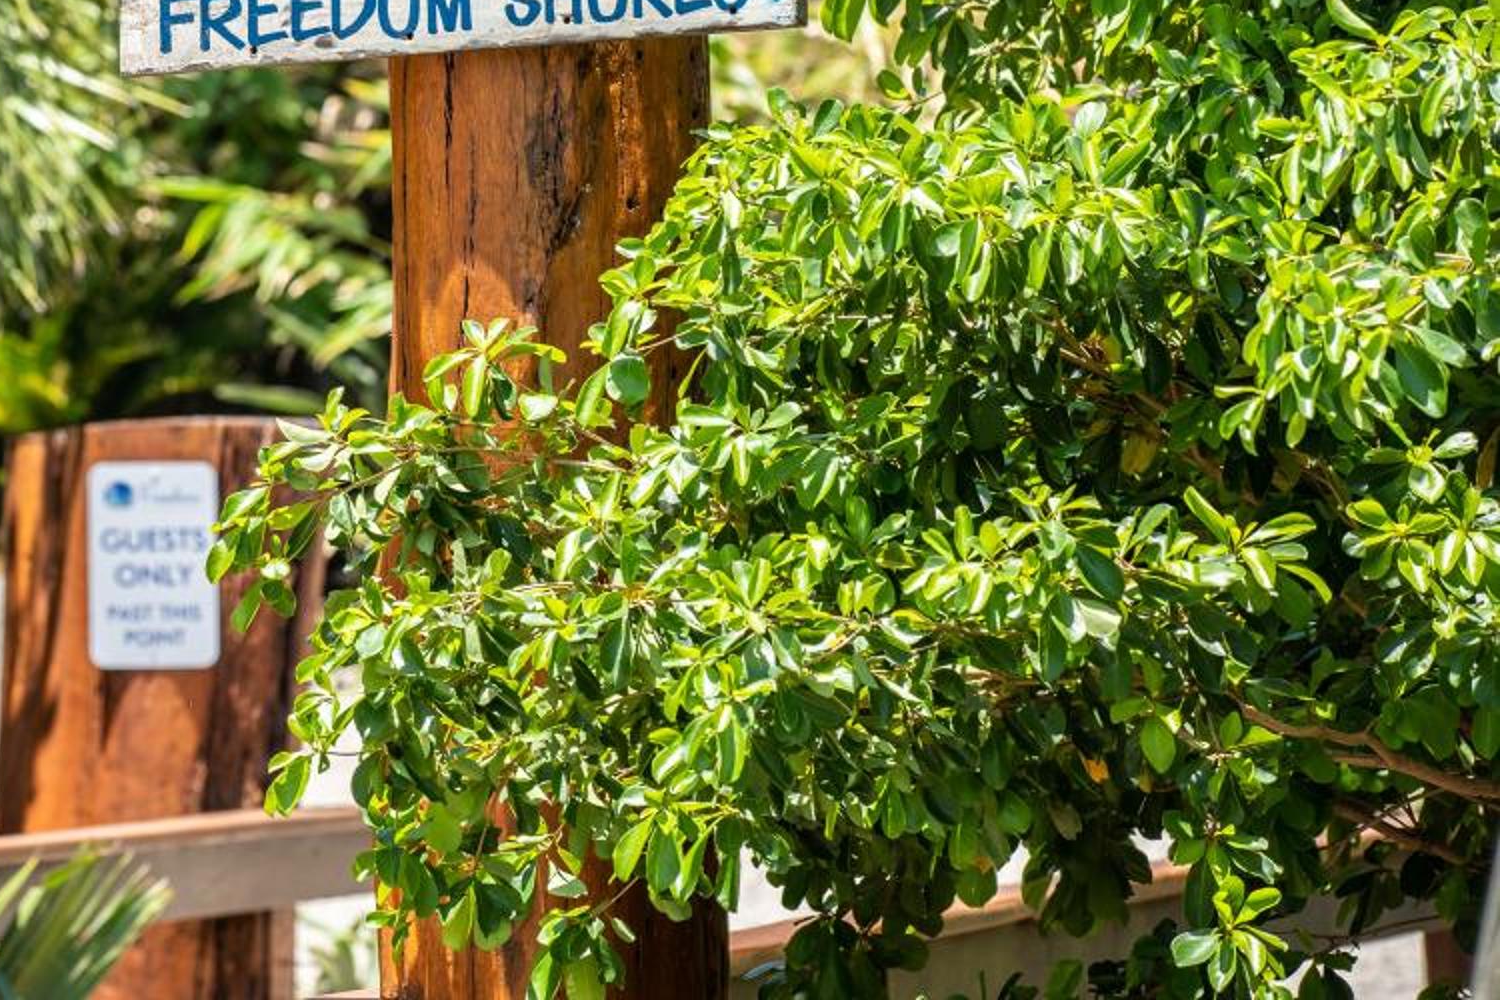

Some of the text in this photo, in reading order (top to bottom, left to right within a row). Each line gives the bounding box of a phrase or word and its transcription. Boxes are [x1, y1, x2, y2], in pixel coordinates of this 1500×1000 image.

[100, 527, 207, 554] GUESTS
[114, 563, 194, 588] ONLY
[106, 603, 203, 622] PAST THIS
[123, 628, 185, 647] POINT
